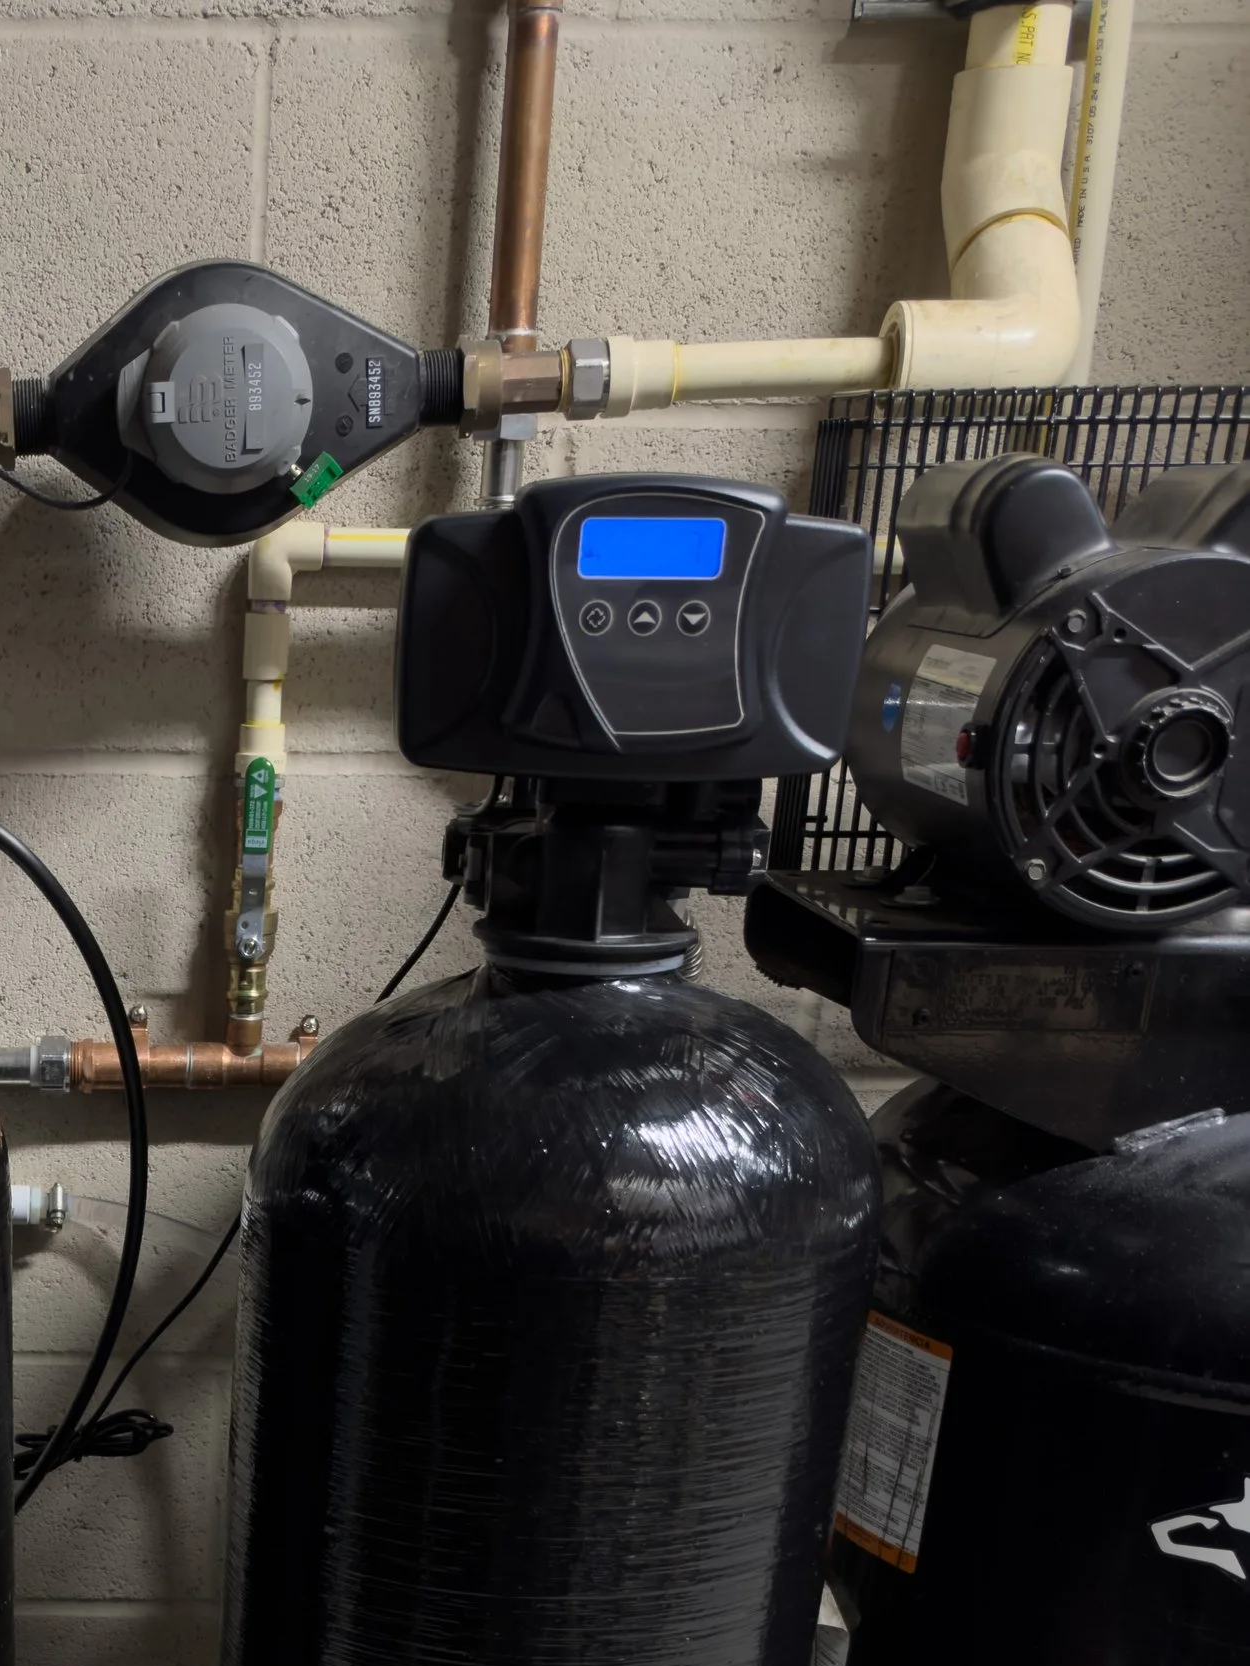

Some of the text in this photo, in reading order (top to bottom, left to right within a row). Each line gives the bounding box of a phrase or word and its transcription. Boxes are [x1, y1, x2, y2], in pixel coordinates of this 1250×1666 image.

[1077, 205, 1085, 227] MADE
[1080, 189, 1087, 200] IN
[223, 336, 237, 463] BADGER METER
[248, 362, 262, 411] 893452
[368, 360, 381, 423] SN893452
